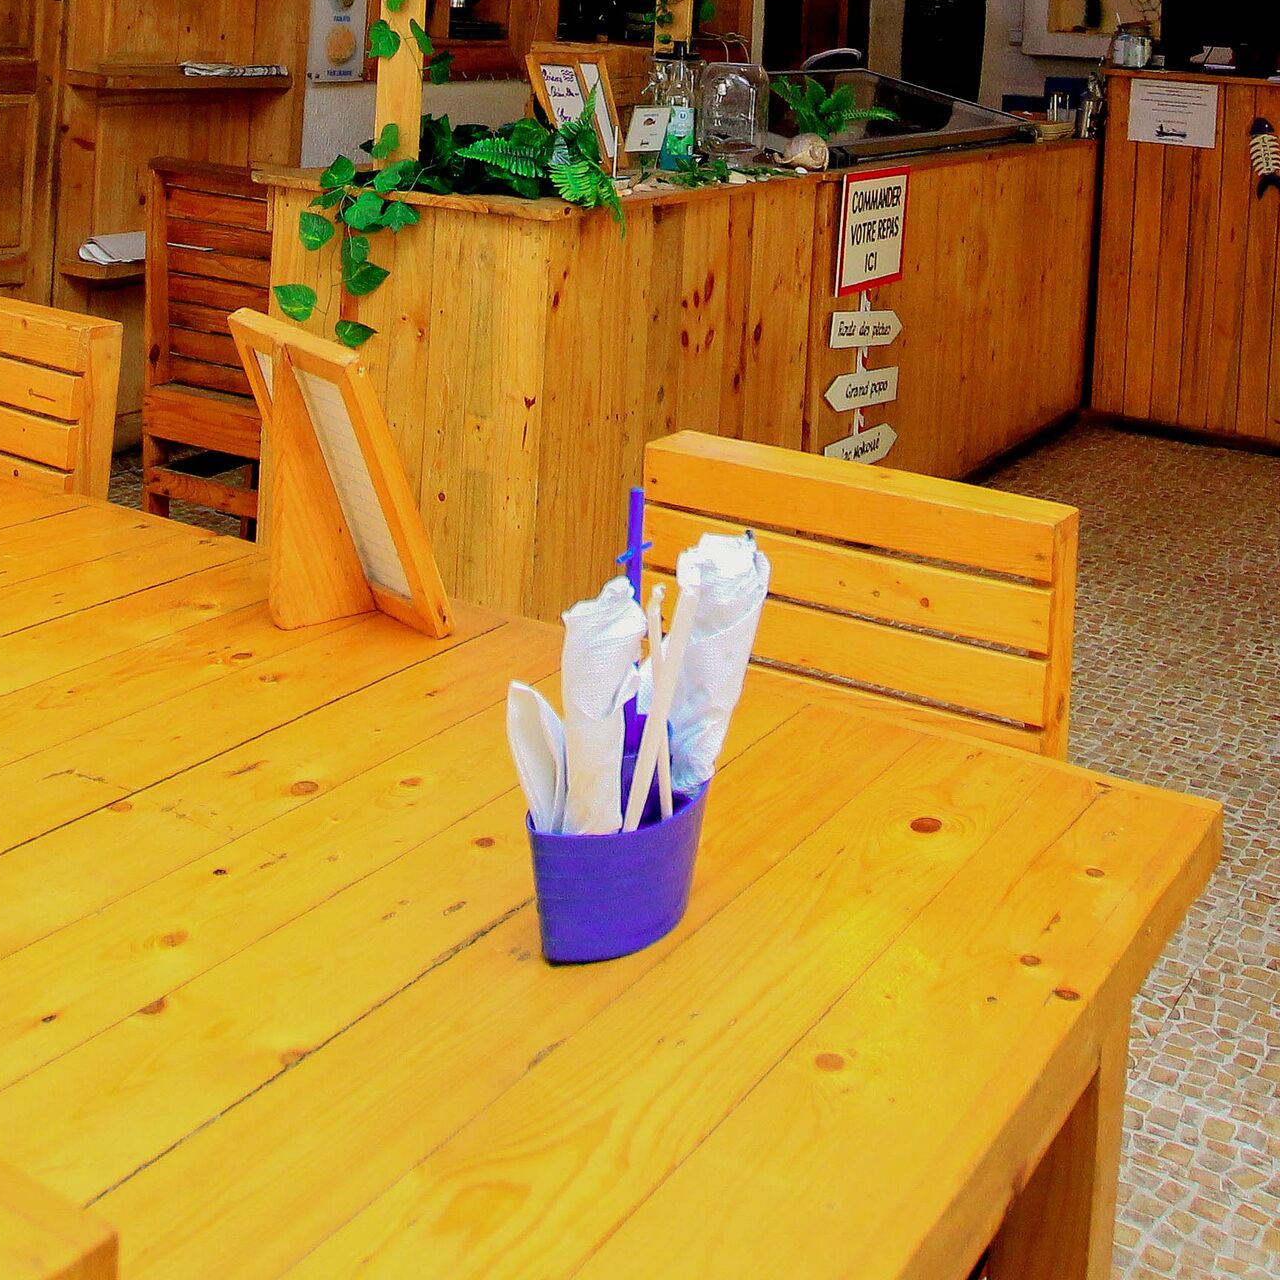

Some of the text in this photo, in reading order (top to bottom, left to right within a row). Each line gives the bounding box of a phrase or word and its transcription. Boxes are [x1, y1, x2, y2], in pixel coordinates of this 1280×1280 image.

[852, 185, 902, 213] COMMANDER
[851, 215, 899, 246] VOTRE REPAS
[864, 252, 877, 273] ICI
[859, 321, 870, 336] des
[845, 381, 869, 398] Grand
